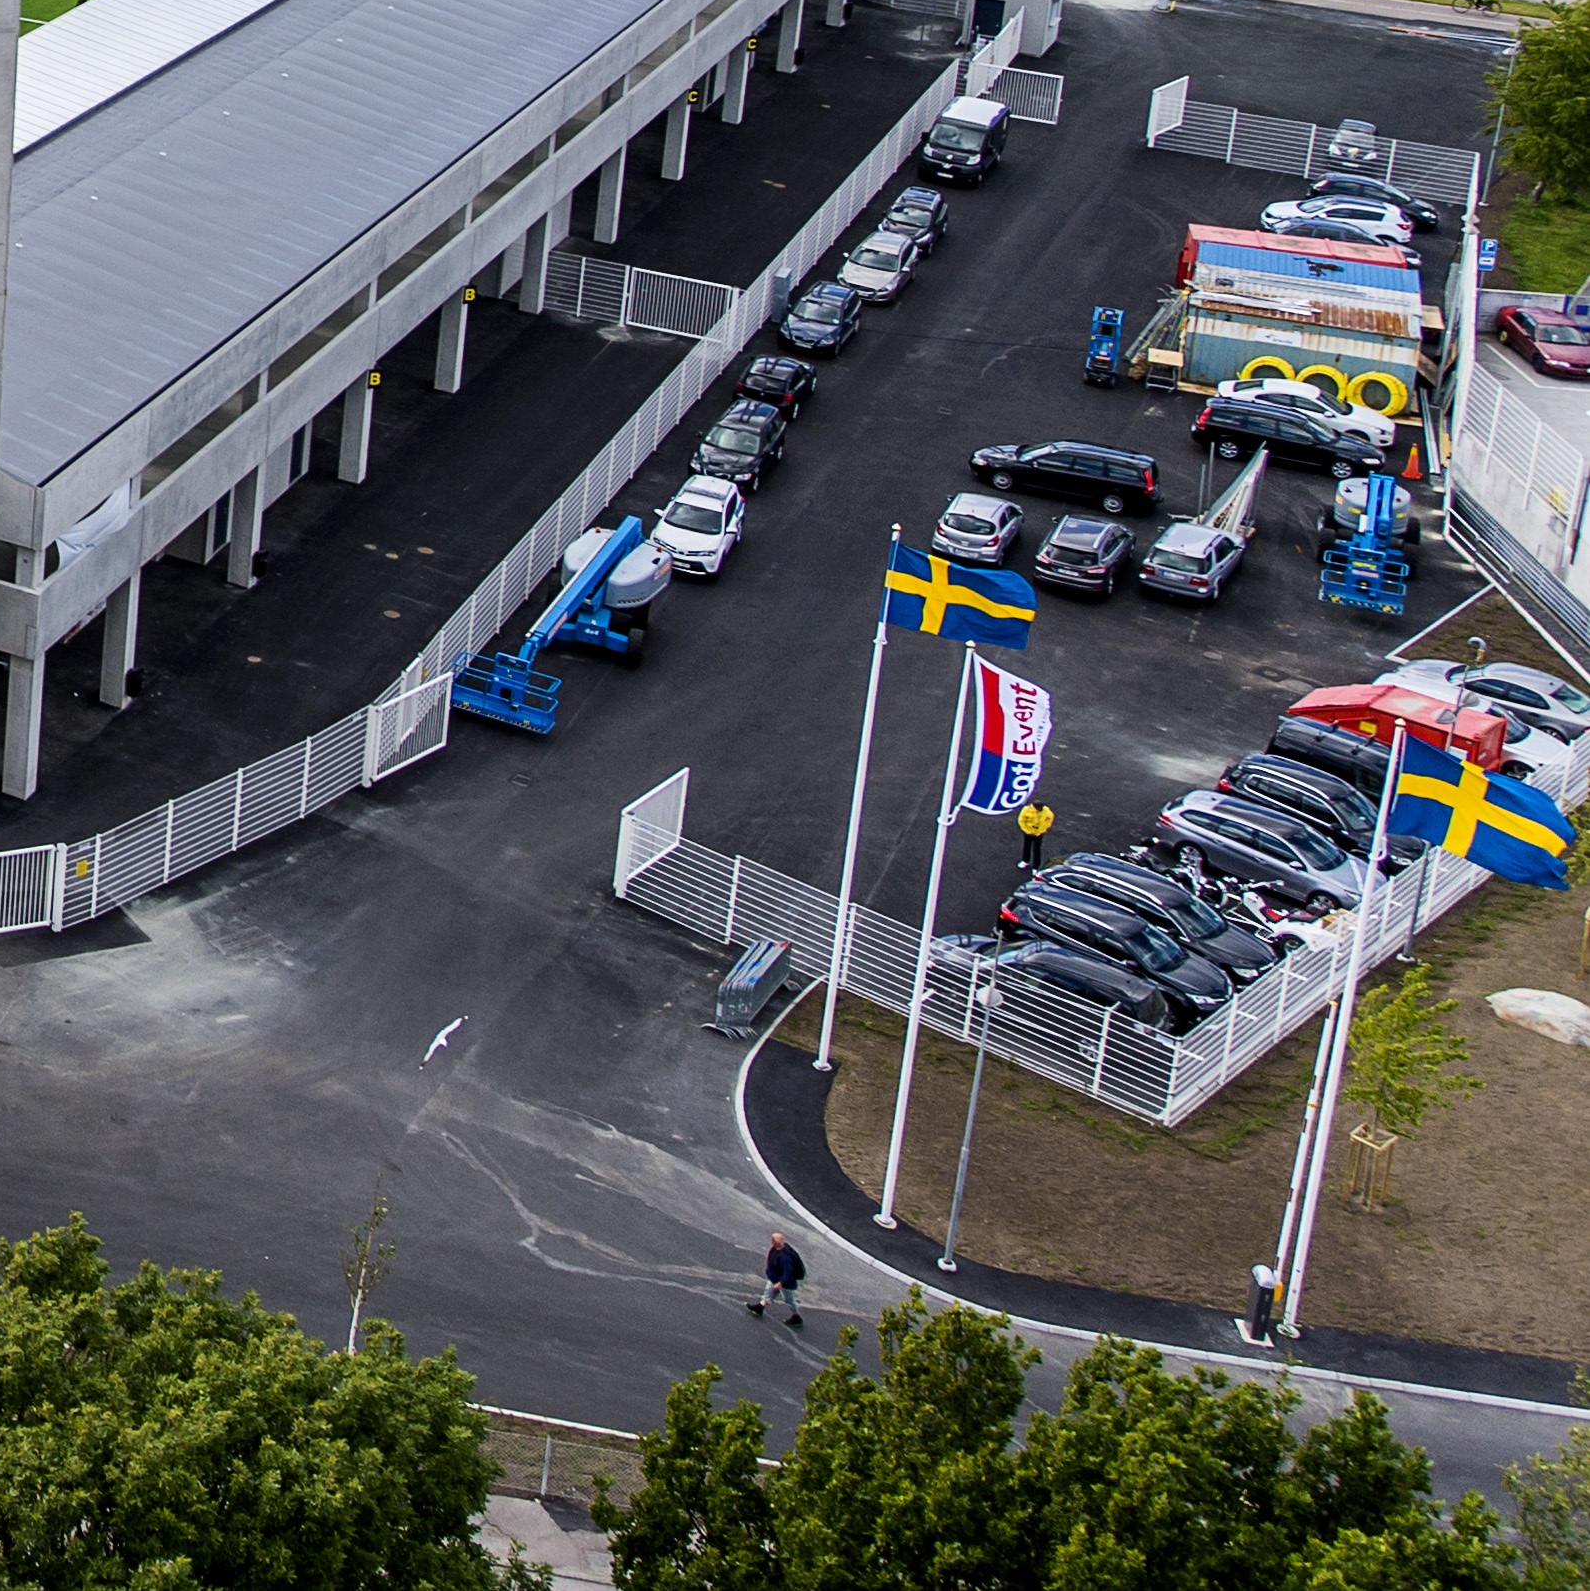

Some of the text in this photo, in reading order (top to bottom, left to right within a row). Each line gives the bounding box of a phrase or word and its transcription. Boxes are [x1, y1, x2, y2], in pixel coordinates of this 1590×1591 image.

[688, 91, 698, 102] C
[465, 288, 476, 301] B
[1000, 681, 1038, 809] Got Event
